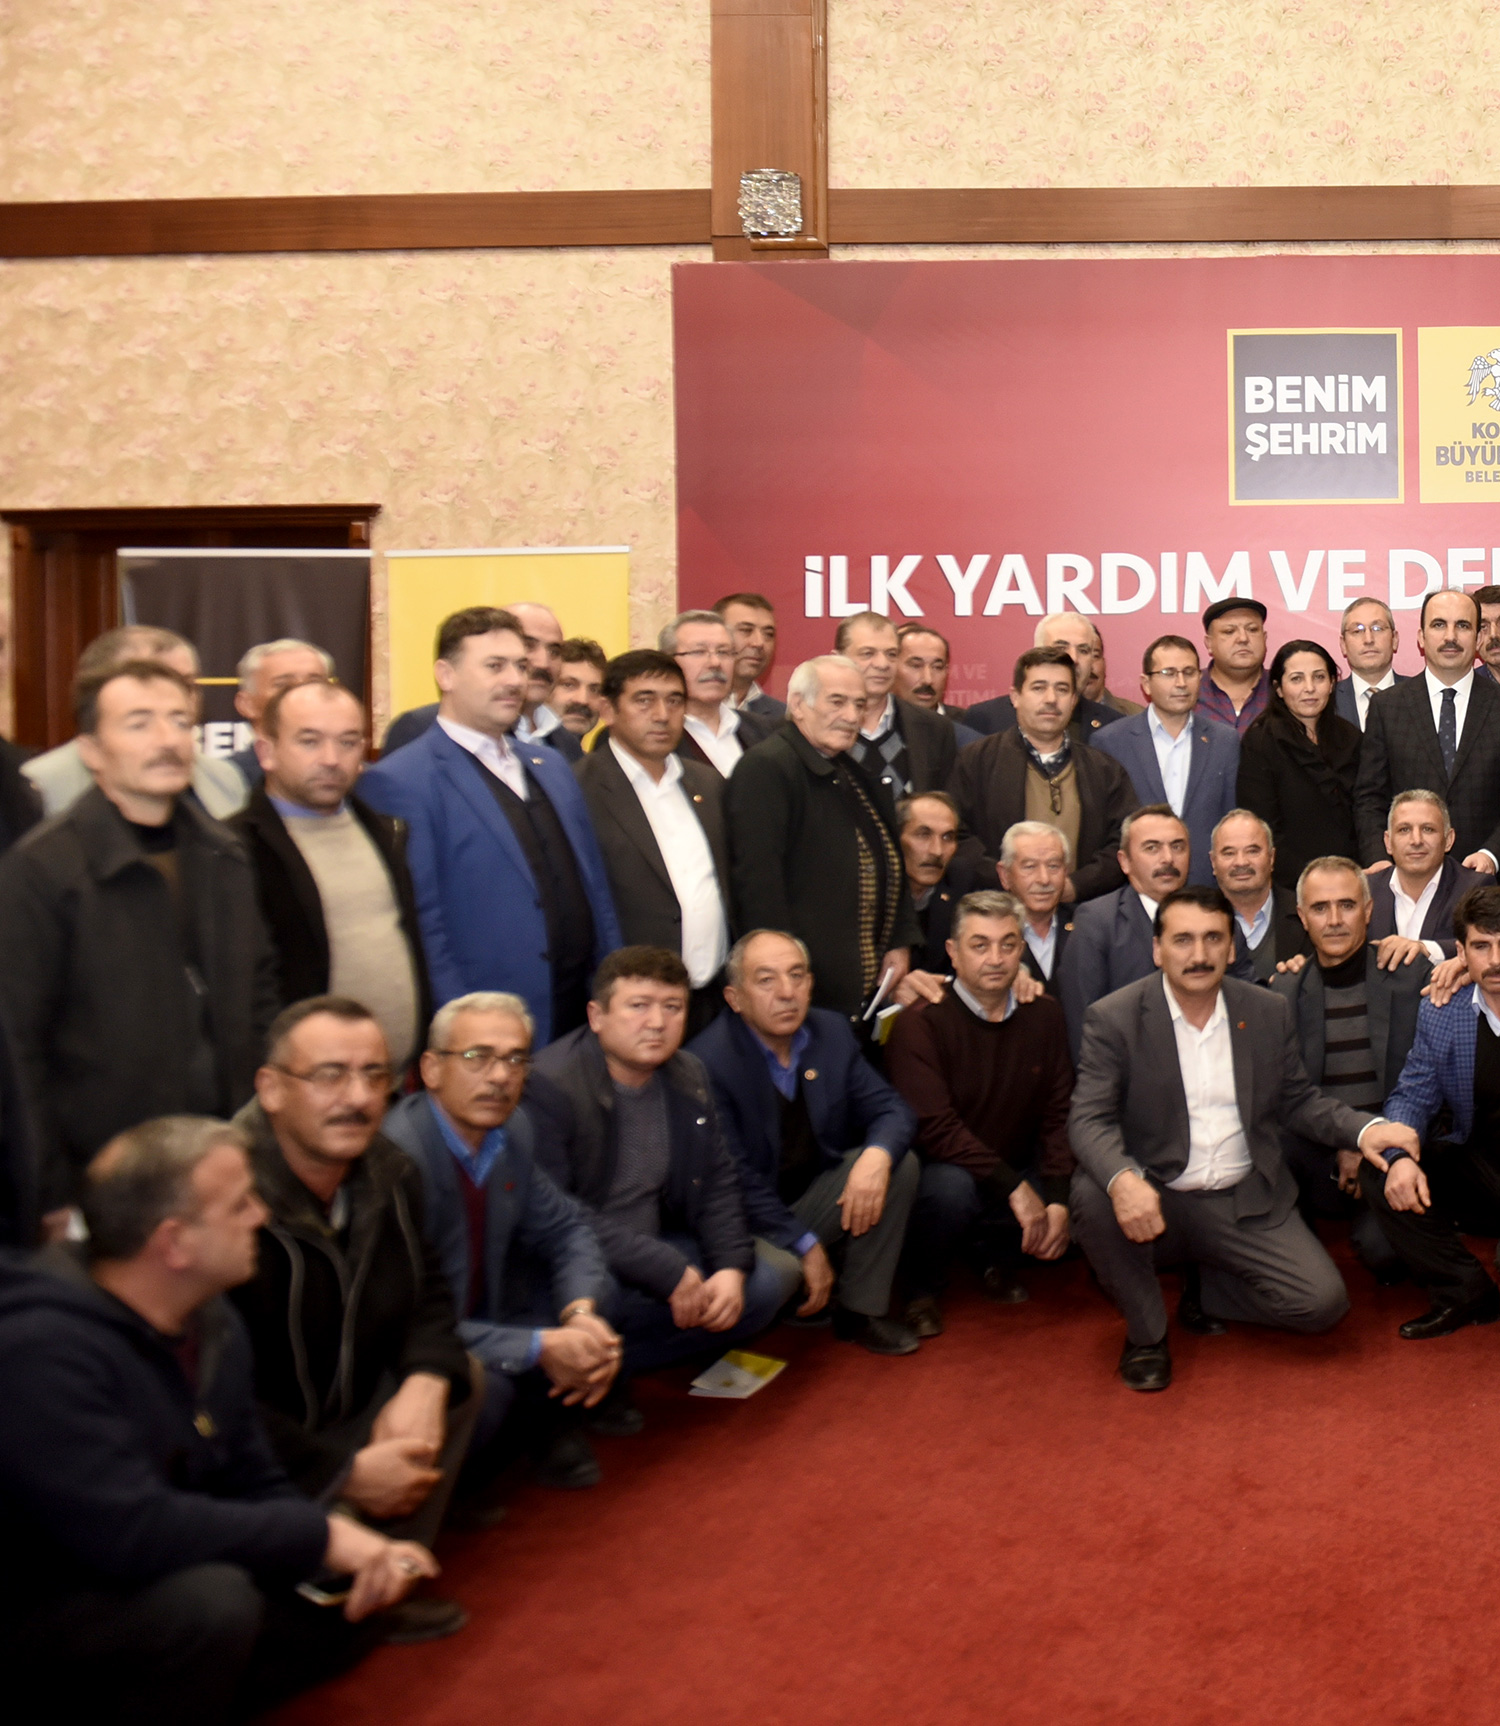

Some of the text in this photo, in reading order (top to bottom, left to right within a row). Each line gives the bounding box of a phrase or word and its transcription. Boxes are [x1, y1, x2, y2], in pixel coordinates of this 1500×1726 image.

[1245, 374, 1387, 413] BENİM
[1245, 421, 1387, 461] ŞEHRİM
[804, 555, 925, 617] İLK
[935, 551, 1254, 616] YARDIM
[1268, 550, 1366, 612] VE
